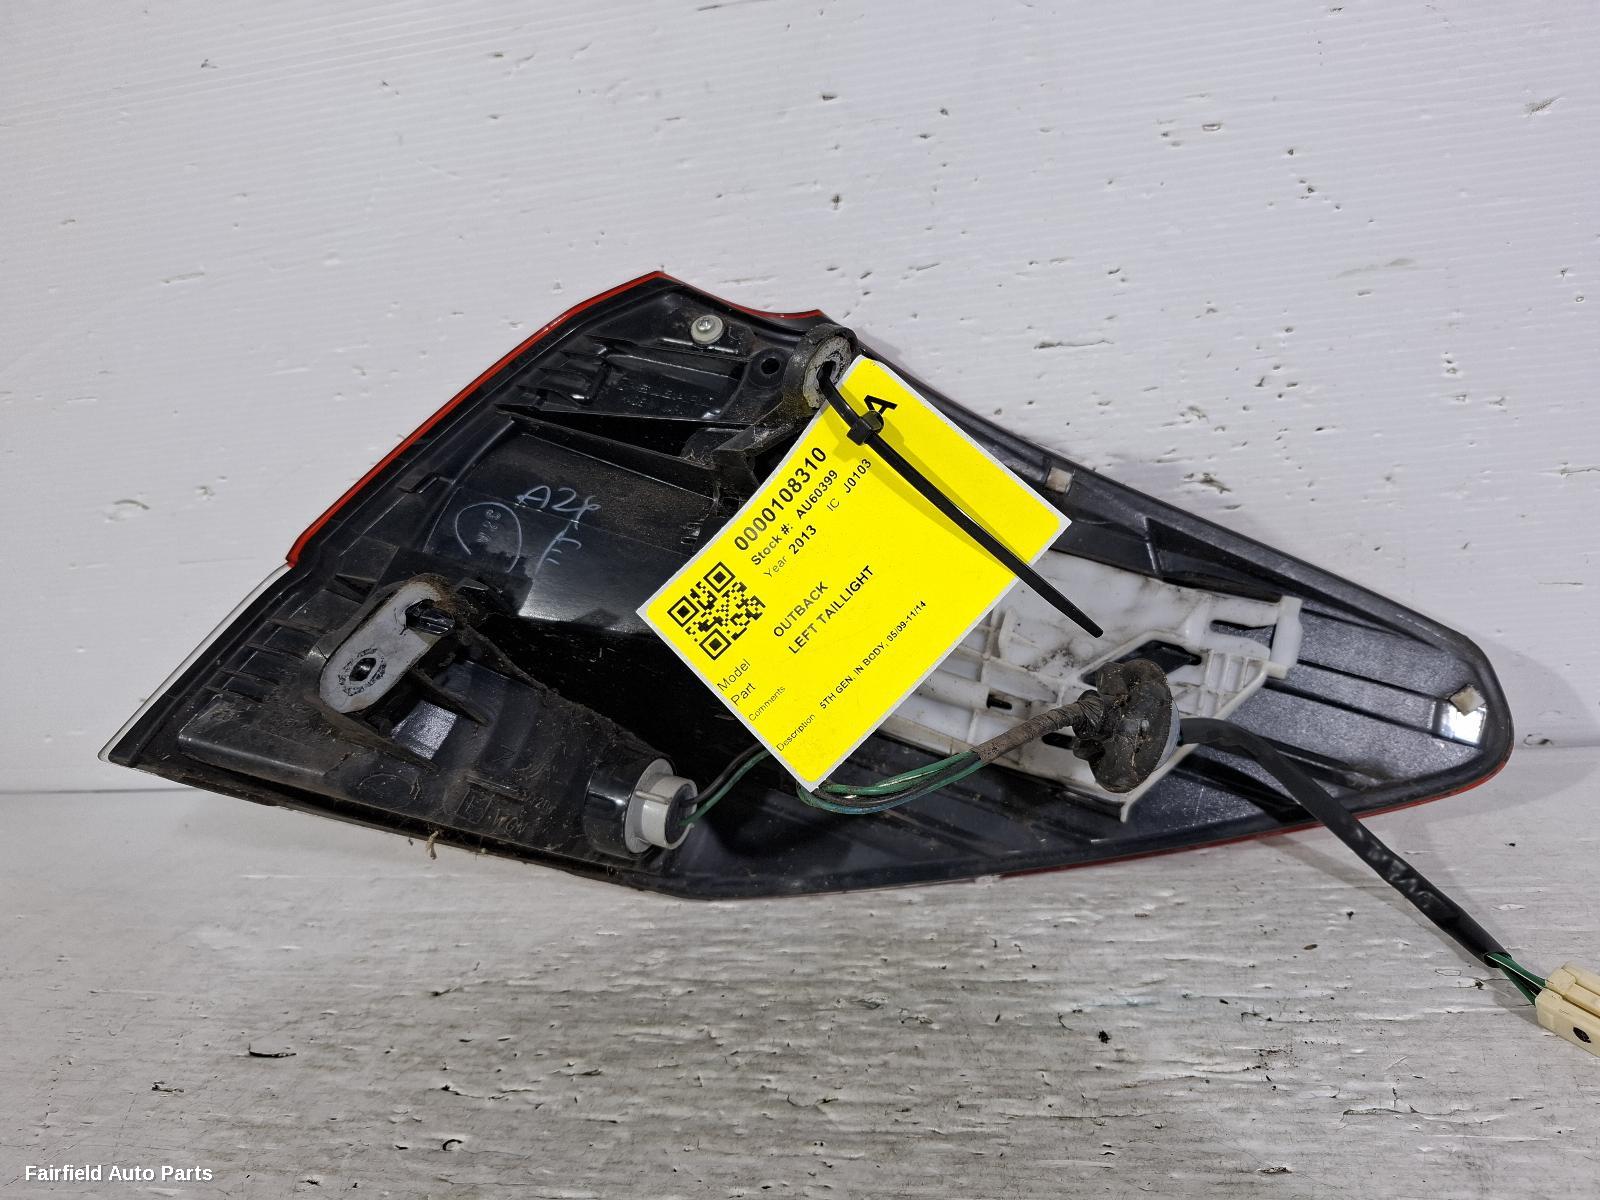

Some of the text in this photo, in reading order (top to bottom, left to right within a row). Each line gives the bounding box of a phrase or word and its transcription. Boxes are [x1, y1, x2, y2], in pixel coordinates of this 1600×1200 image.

[863, 394, 898, 416] A
[734, 447, 826, 551] 0000108310
[751, 469, 838, 565] Stock #: AU60399
[763, 458, 872, 578] Year 2013 IC J0103
[717, 581, 829, 692] Model OUTBACK
[730, 564, 873, 707] Part LEFT TAILLIGHT
[776, 713, 816, 752] Description
[819, 692, 837, 709] 5TH
[853, 664, 865, 676] IN
[886, 600, 927, 642] 05/09-11/14
[748, 685, 786, 722] Comments
